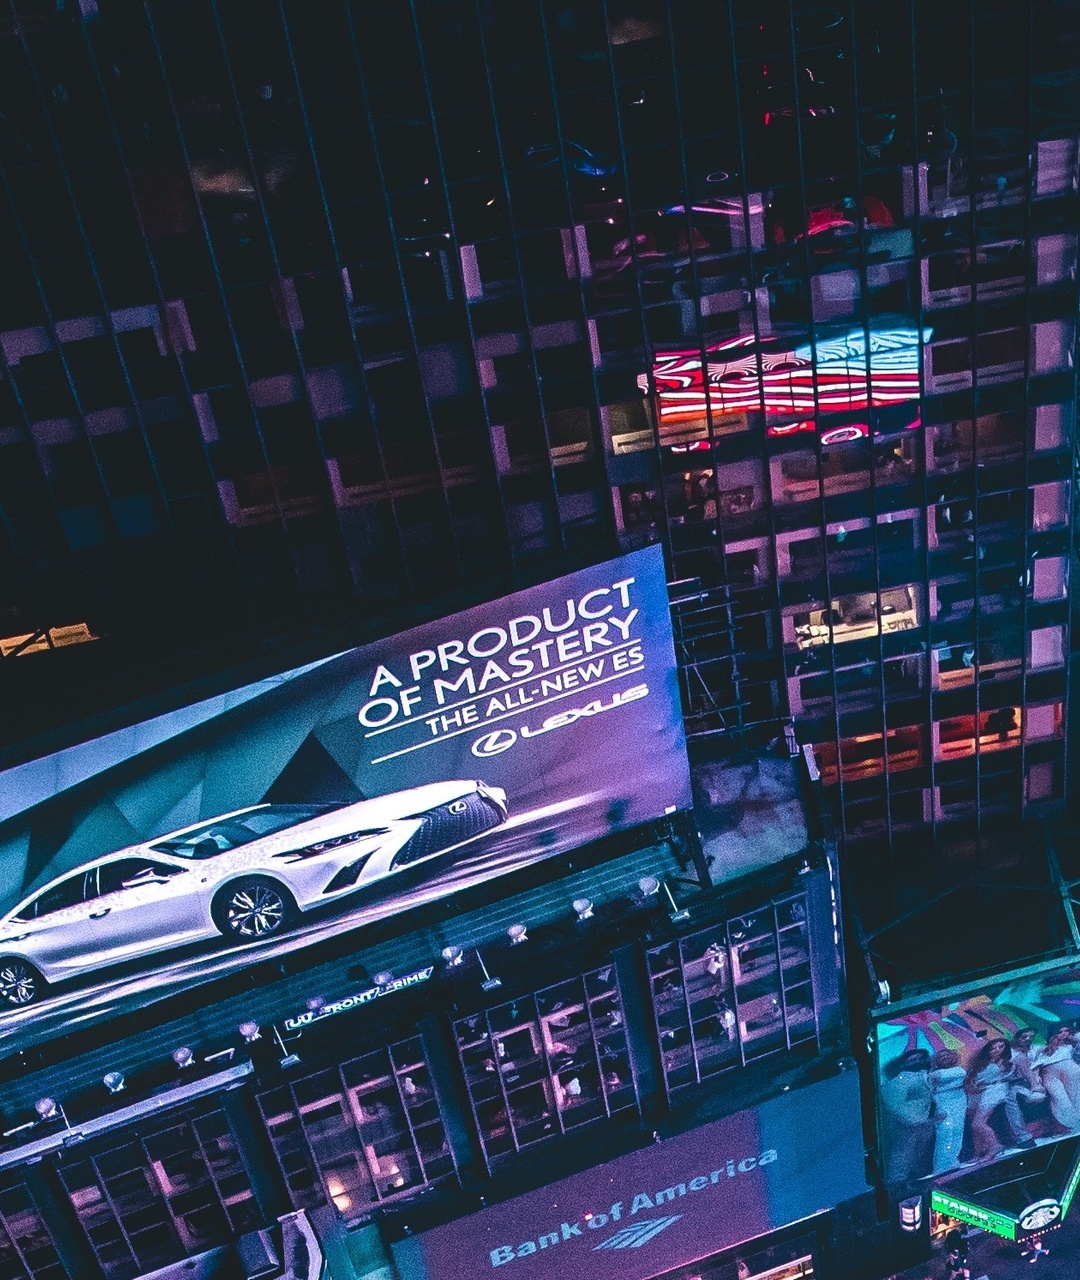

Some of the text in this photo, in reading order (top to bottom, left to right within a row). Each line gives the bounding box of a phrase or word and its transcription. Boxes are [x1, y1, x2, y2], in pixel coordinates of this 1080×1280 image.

[358, 608, 639, 728] OF MASTERY
[369, 577, 636, 696] A PRODUCT
[425, 646, 645, 736] THE ALL-NEW ES
[520, 683, 650, 738] LEXUS
[489, 1149, 778, 1268] Bank of America
